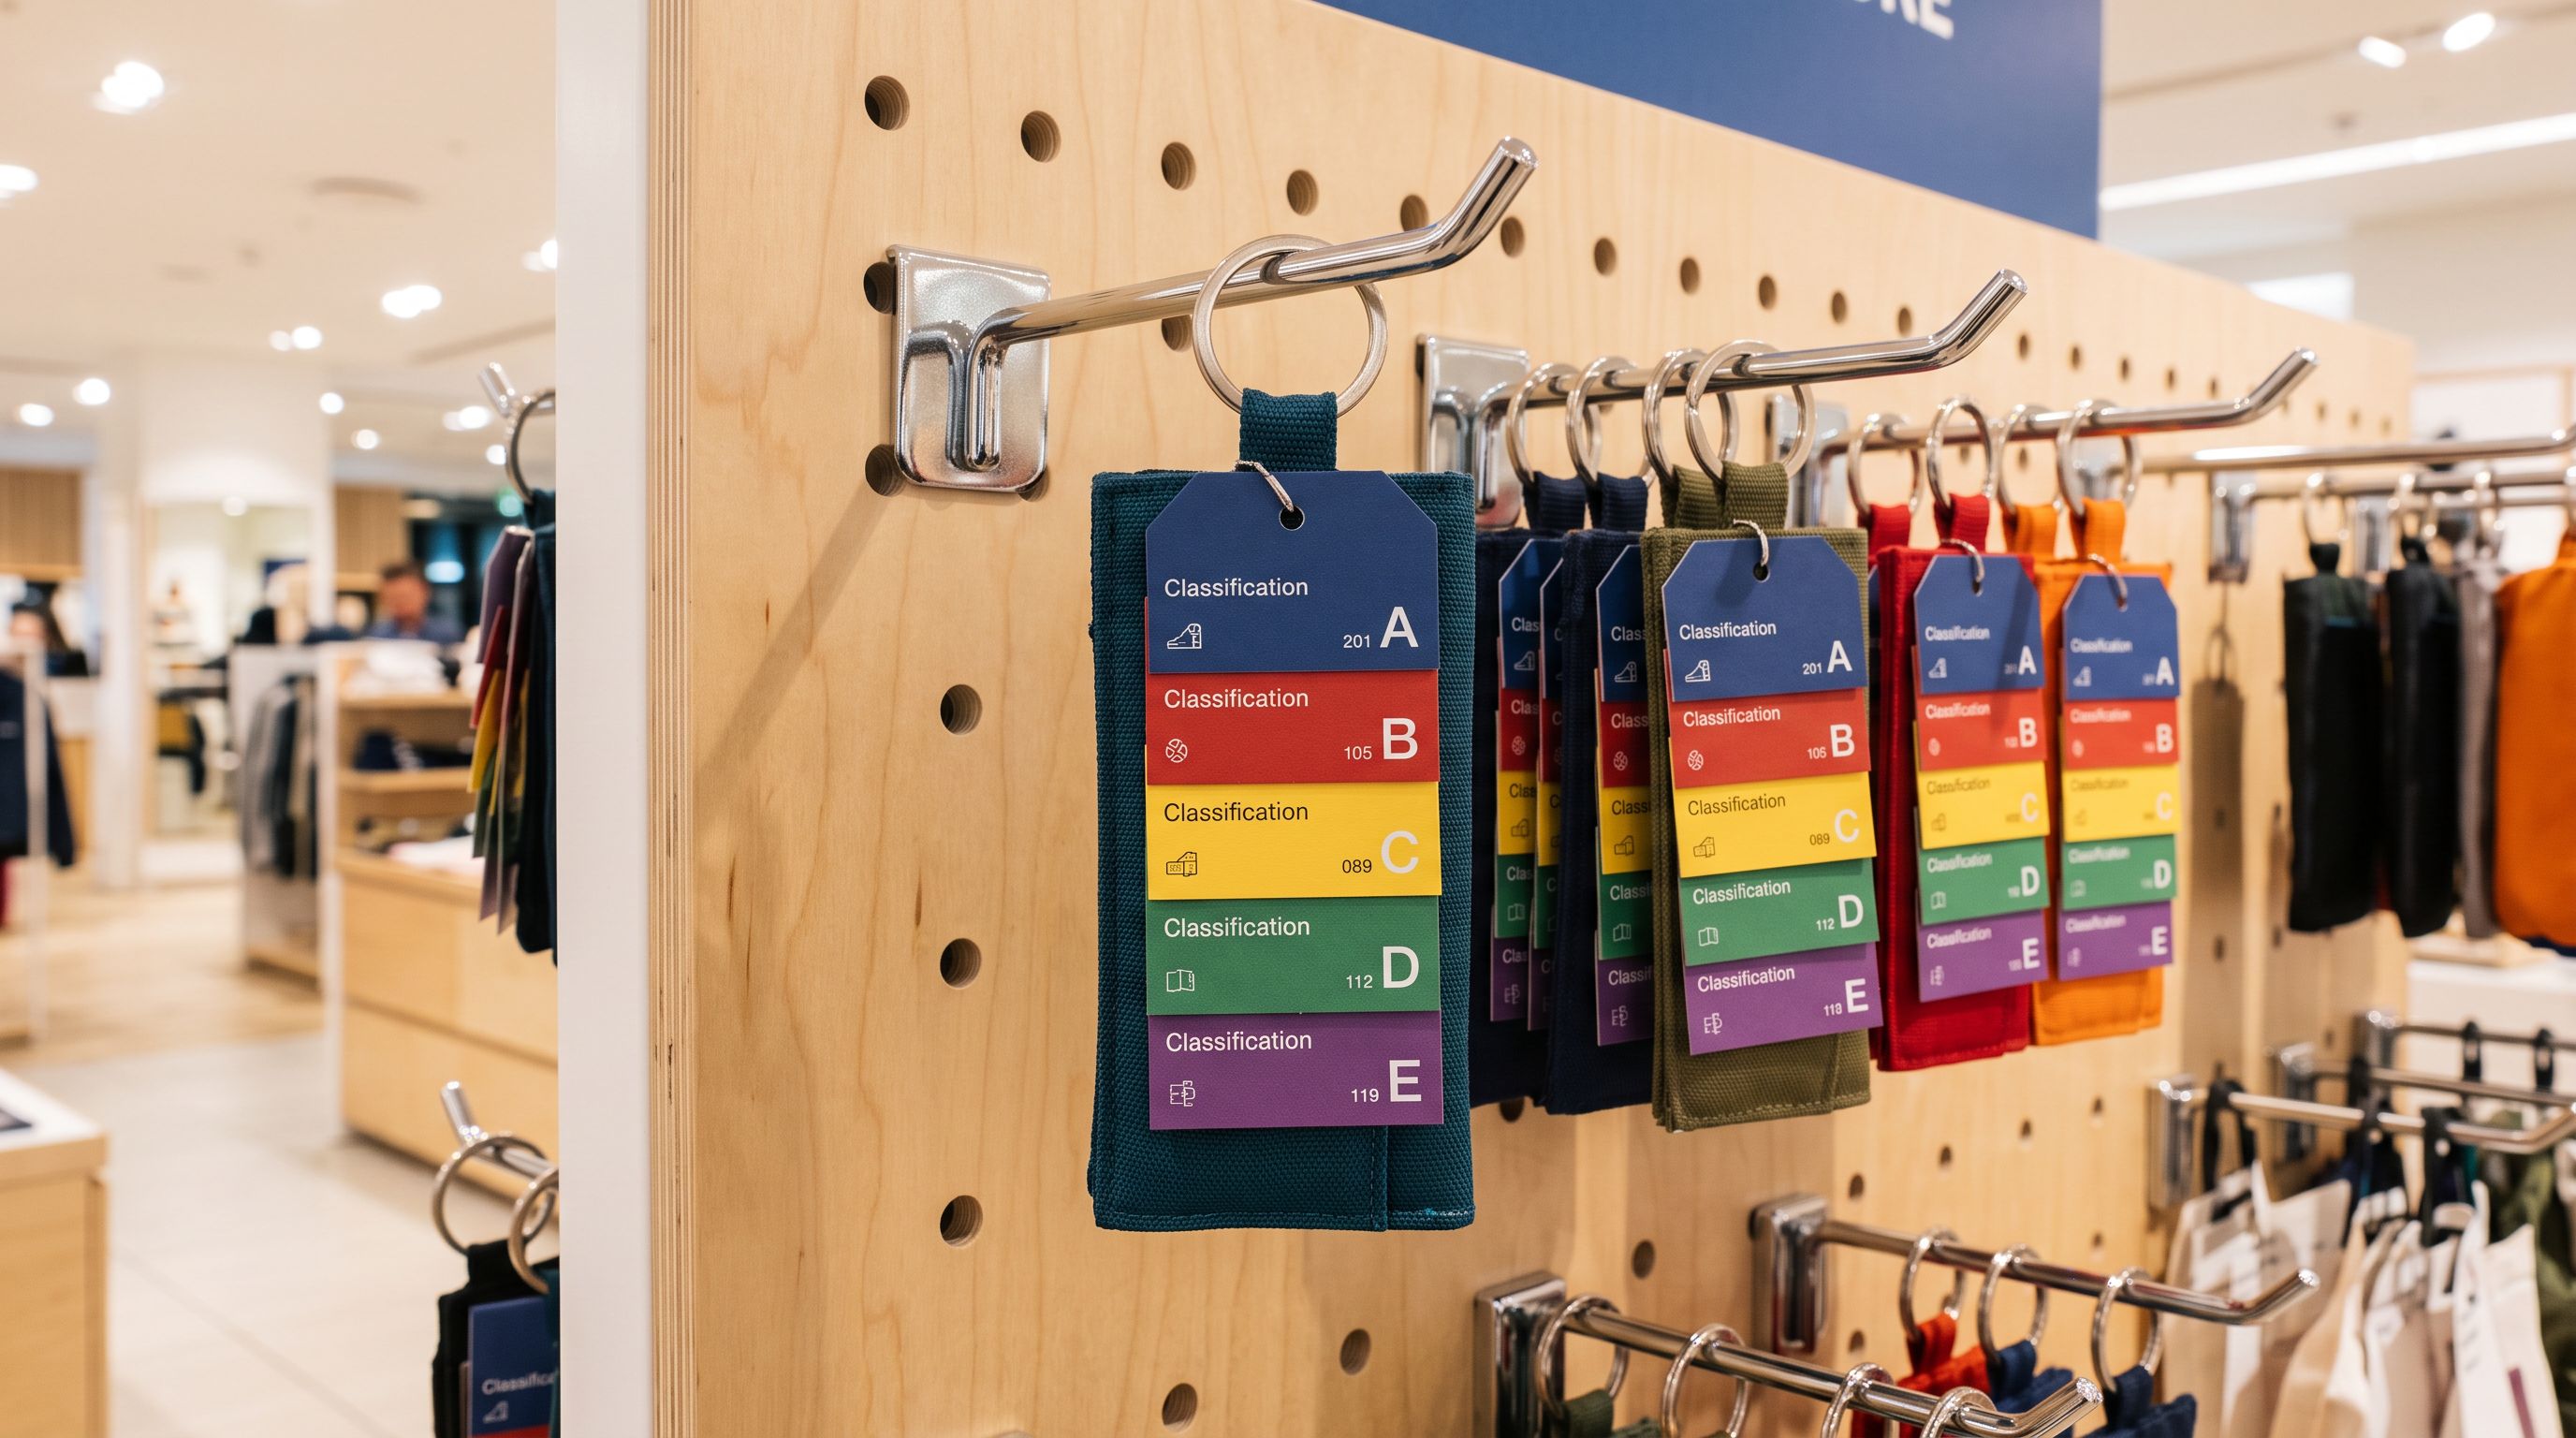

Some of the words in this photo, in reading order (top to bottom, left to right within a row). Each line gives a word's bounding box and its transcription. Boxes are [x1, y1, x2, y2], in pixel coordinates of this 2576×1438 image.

[1164, 577, 1309, 597] Classification
[1343, 634, 1370, 649] 201
[1379, 606, 1419, 649] A
[1678, 620, 1777, 640] Classification
[1802, 662, 1822, 675] 201
[1826, 639, 1853, 673] A
[2018, 645, 2037, 675] A
[2156, 656, 2174, 686] A
[1164, 687, 1309, 709] Classification
[1681, 705, 1782, 728] Classification
[1343, 745, 1372, 760] 105
[1383, 717, 1418, 760] B
[1829, 723, 1855, 757] B
[2019, 717, 2038, 748] B
[2156, 723, 2174, 753] B
[1164, 800, 1309, 822] Classification
[1688, 793, 1786, 816] Classification
[2021, 792, 2039, 823] C
[2156, 791, 2174, 820] C
[1808, 832, 1831, 846] 089
[1834, 808, 1860, 844] C
[1341, 858, 1372, 873] 089
[1381, 829, 1419, 874] C
[2021, 865, 2040, 897] D
[2153, 859, 2172, 888] D
[1691, 879, 1793, 906] Classification
[1164, 916, 1310, 938] Classification
[1816, 917, 1836, 932] 112
[1837, 894, 1864, 929] D
[2022, 937, 2041, 970] E
[2151, 926, 2168, 956] E
[1346, 974, 1373, 990] 112
[1383, 946, 1420, 989] D
[1696, 965, 1796, 993] Classification
[1844, 977, 1869, 1014] E
[1165, 1030, 1312, 1052] Classification
[1351, 1088, 1380, 1103] 119
[1388, 1059, 1422, 1103] E
